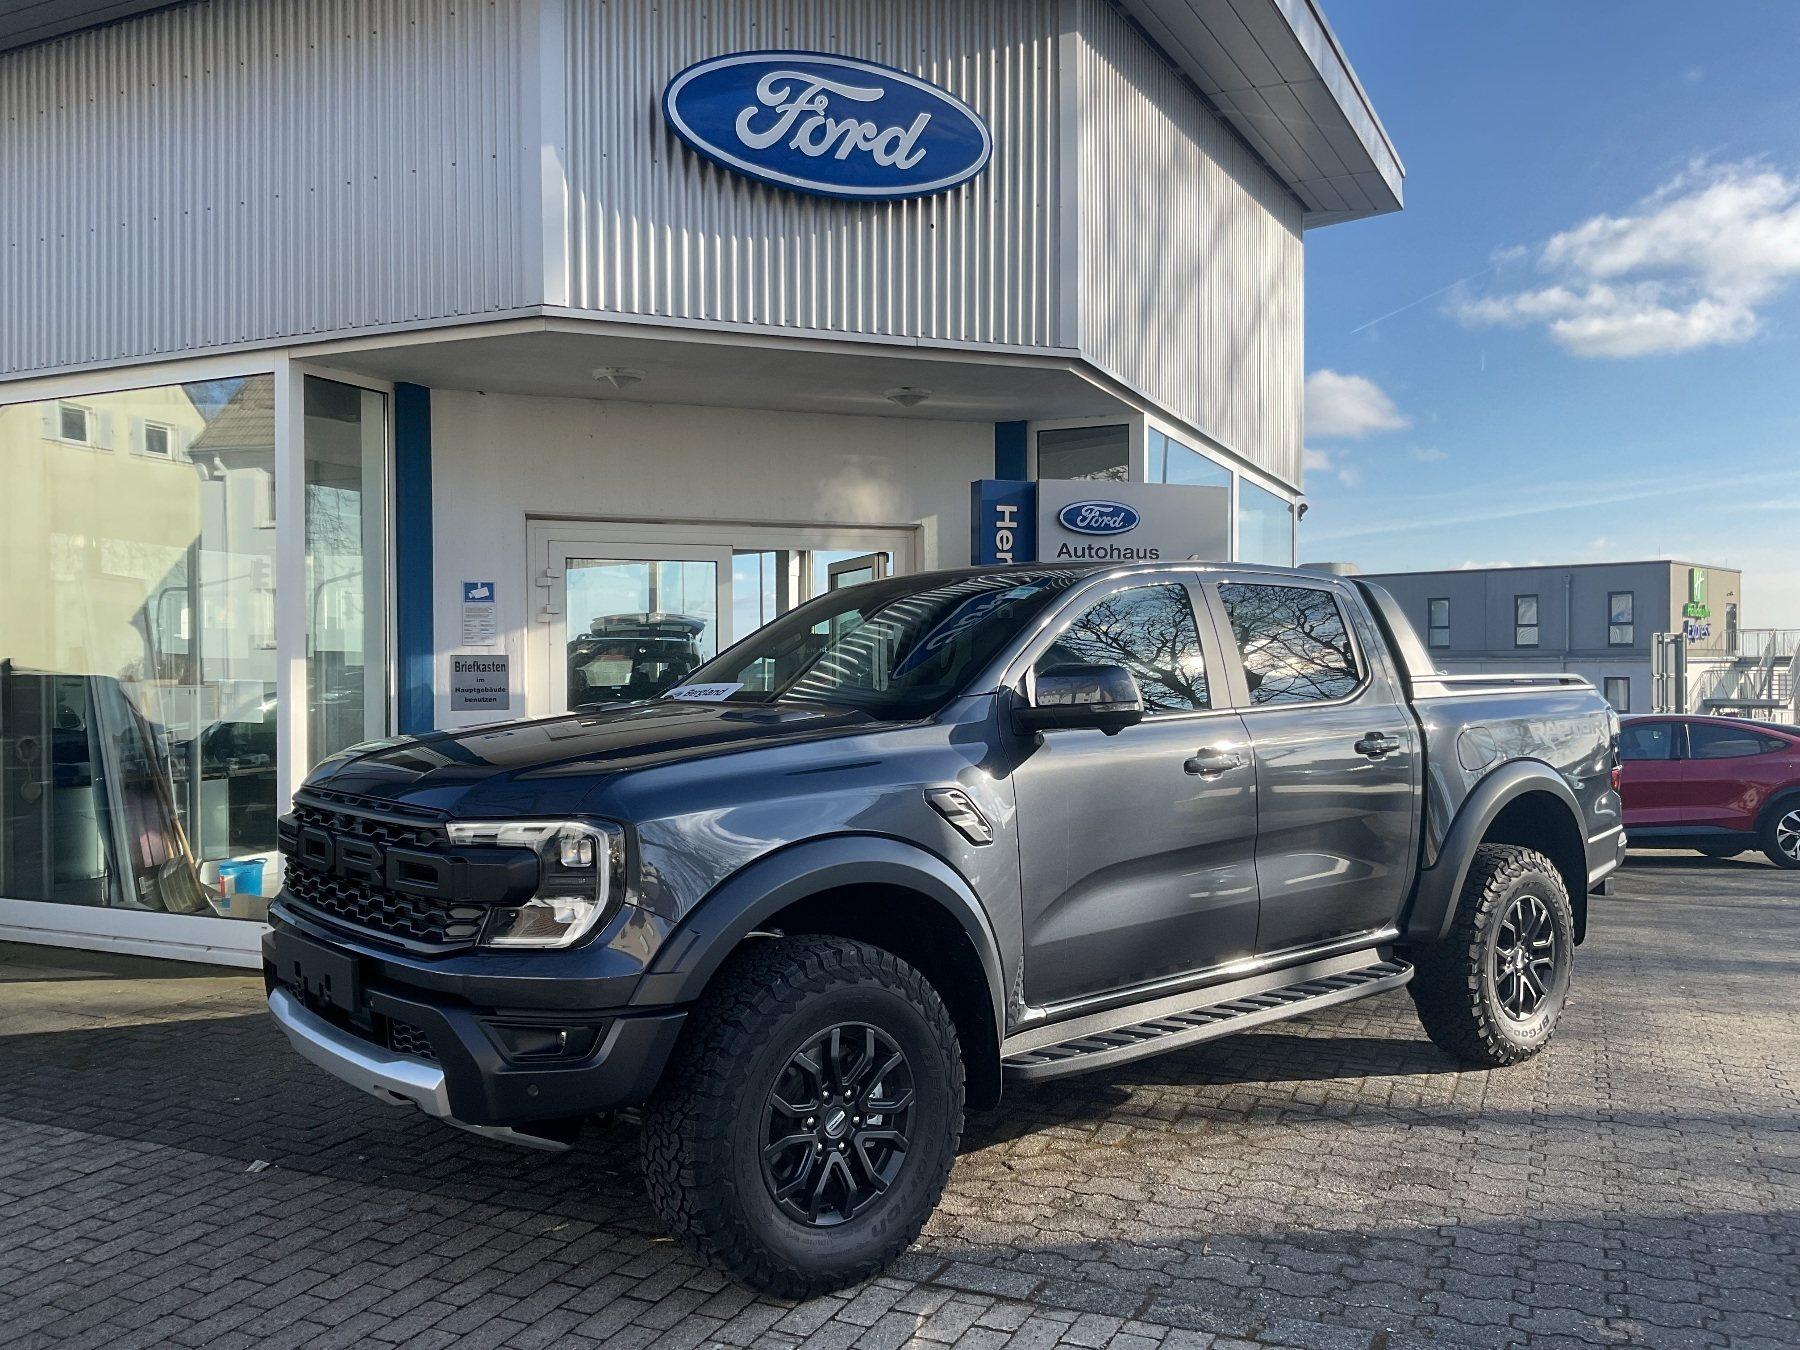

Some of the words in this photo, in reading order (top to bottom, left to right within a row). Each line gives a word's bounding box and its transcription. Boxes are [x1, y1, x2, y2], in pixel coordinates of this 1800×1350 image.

[735, 70, 932, 170] Ford
[1076, 505, 1125, 529] Ford
[1056, 543, 1160, 560] Autohaus
[454, 661, 506, 673] Briefkasten
